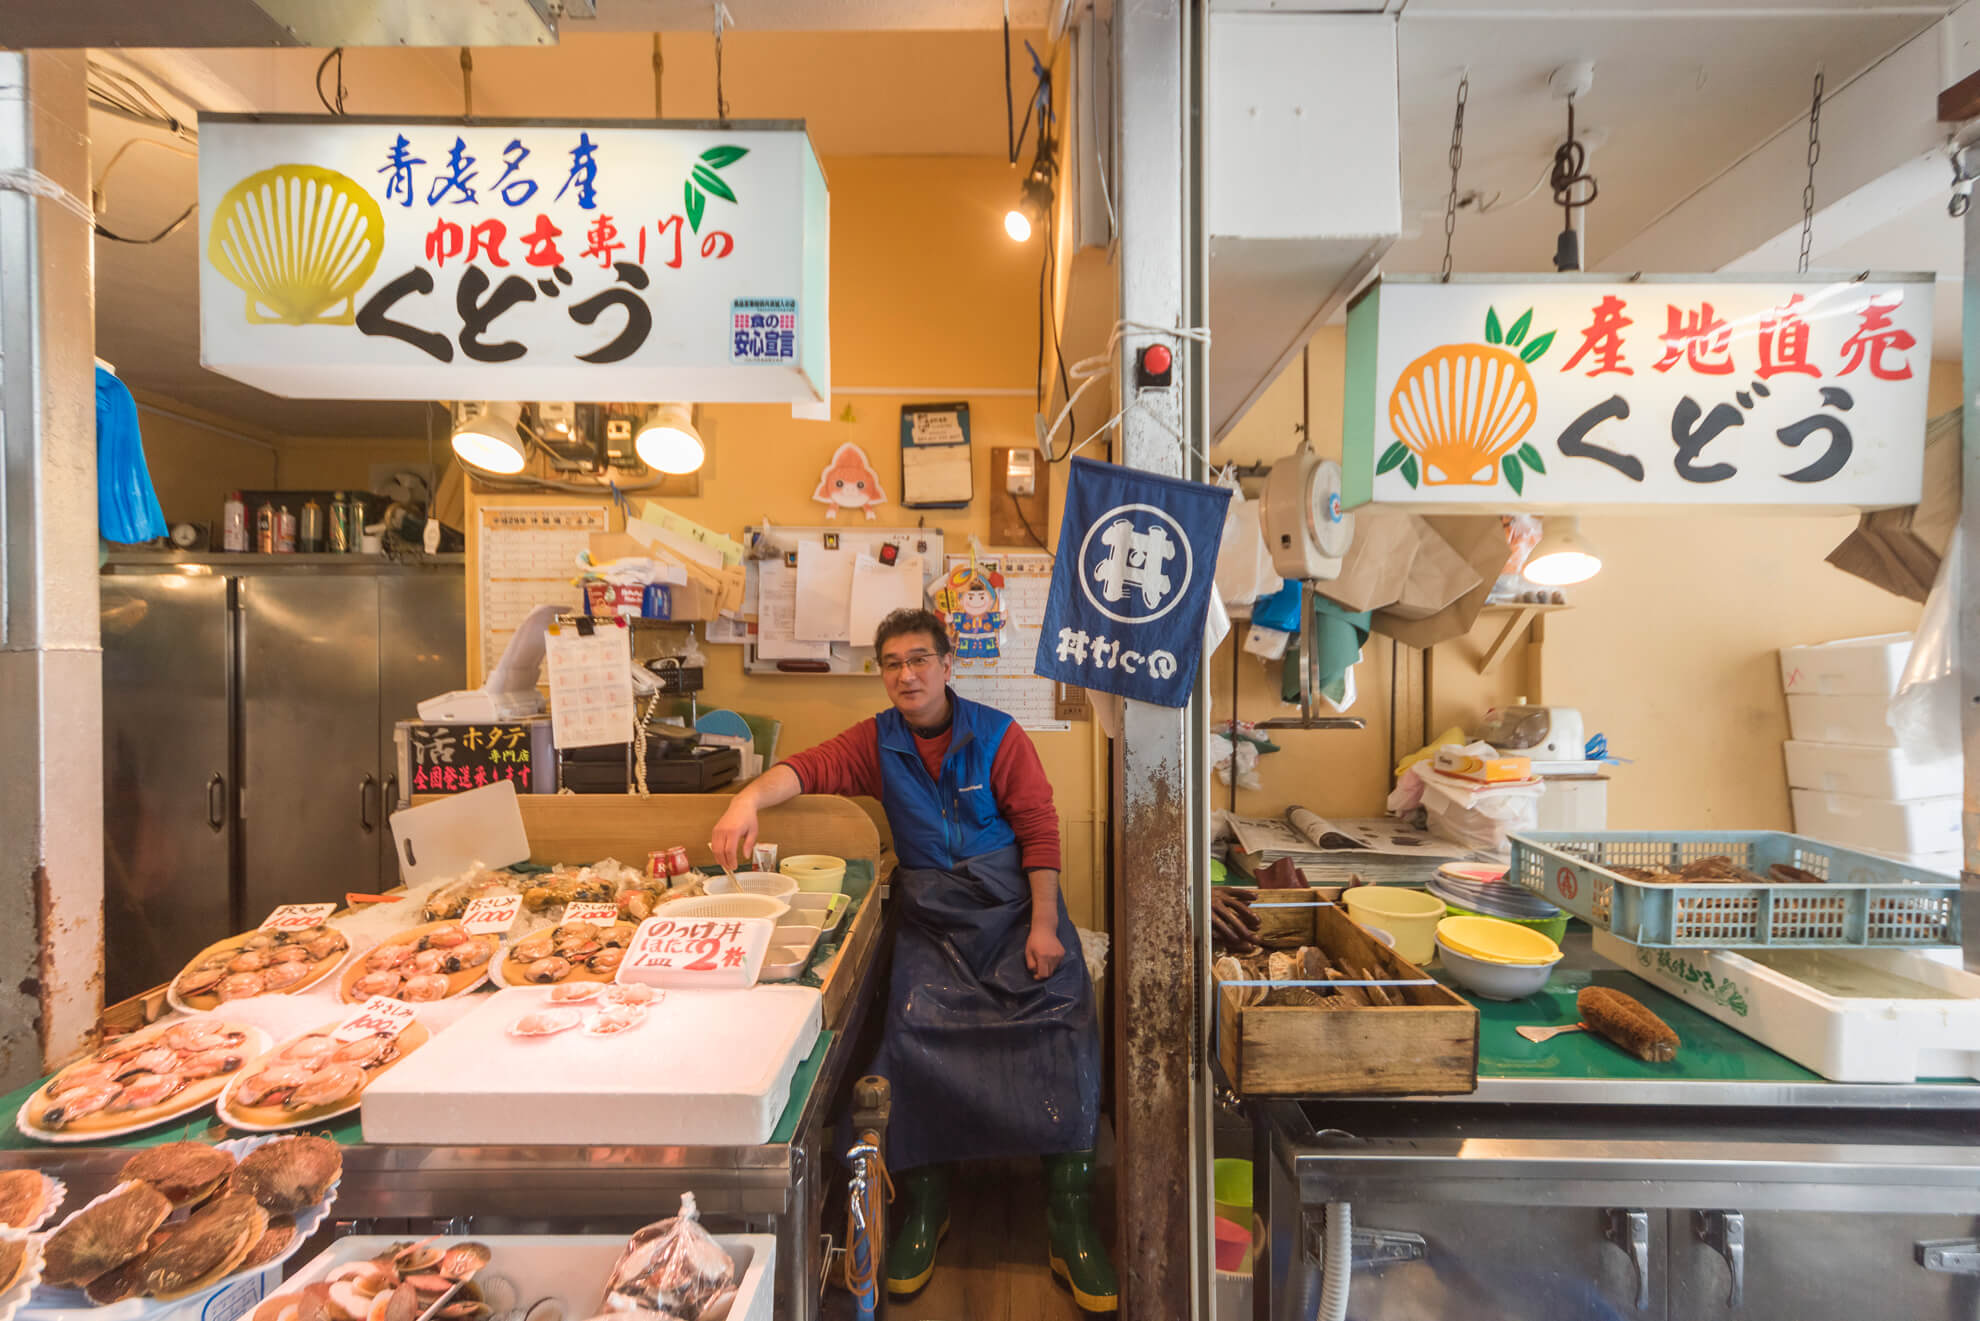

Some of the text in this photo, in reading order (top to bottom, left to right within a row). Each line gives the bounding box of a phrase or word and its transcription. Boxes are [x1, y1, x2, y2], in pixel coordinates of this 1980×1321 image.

[377, 132, 598, 210] 青森名産
[425, 213, 734, 269] 帆立専門の
[355, 261, 653, 364] くどう
[750, 313, 780, 329] 食の
[734, 330, 795, 357] 安心宣言
[1560, 293, 1918, 381] 産地直売
[1556, 381, 1855, 484] くどう
[411, 726, 527, 765] 活 ホタテ
[487, 749, 530, 764] 専門店
[648, 920, 745, 942] のっけ丼
